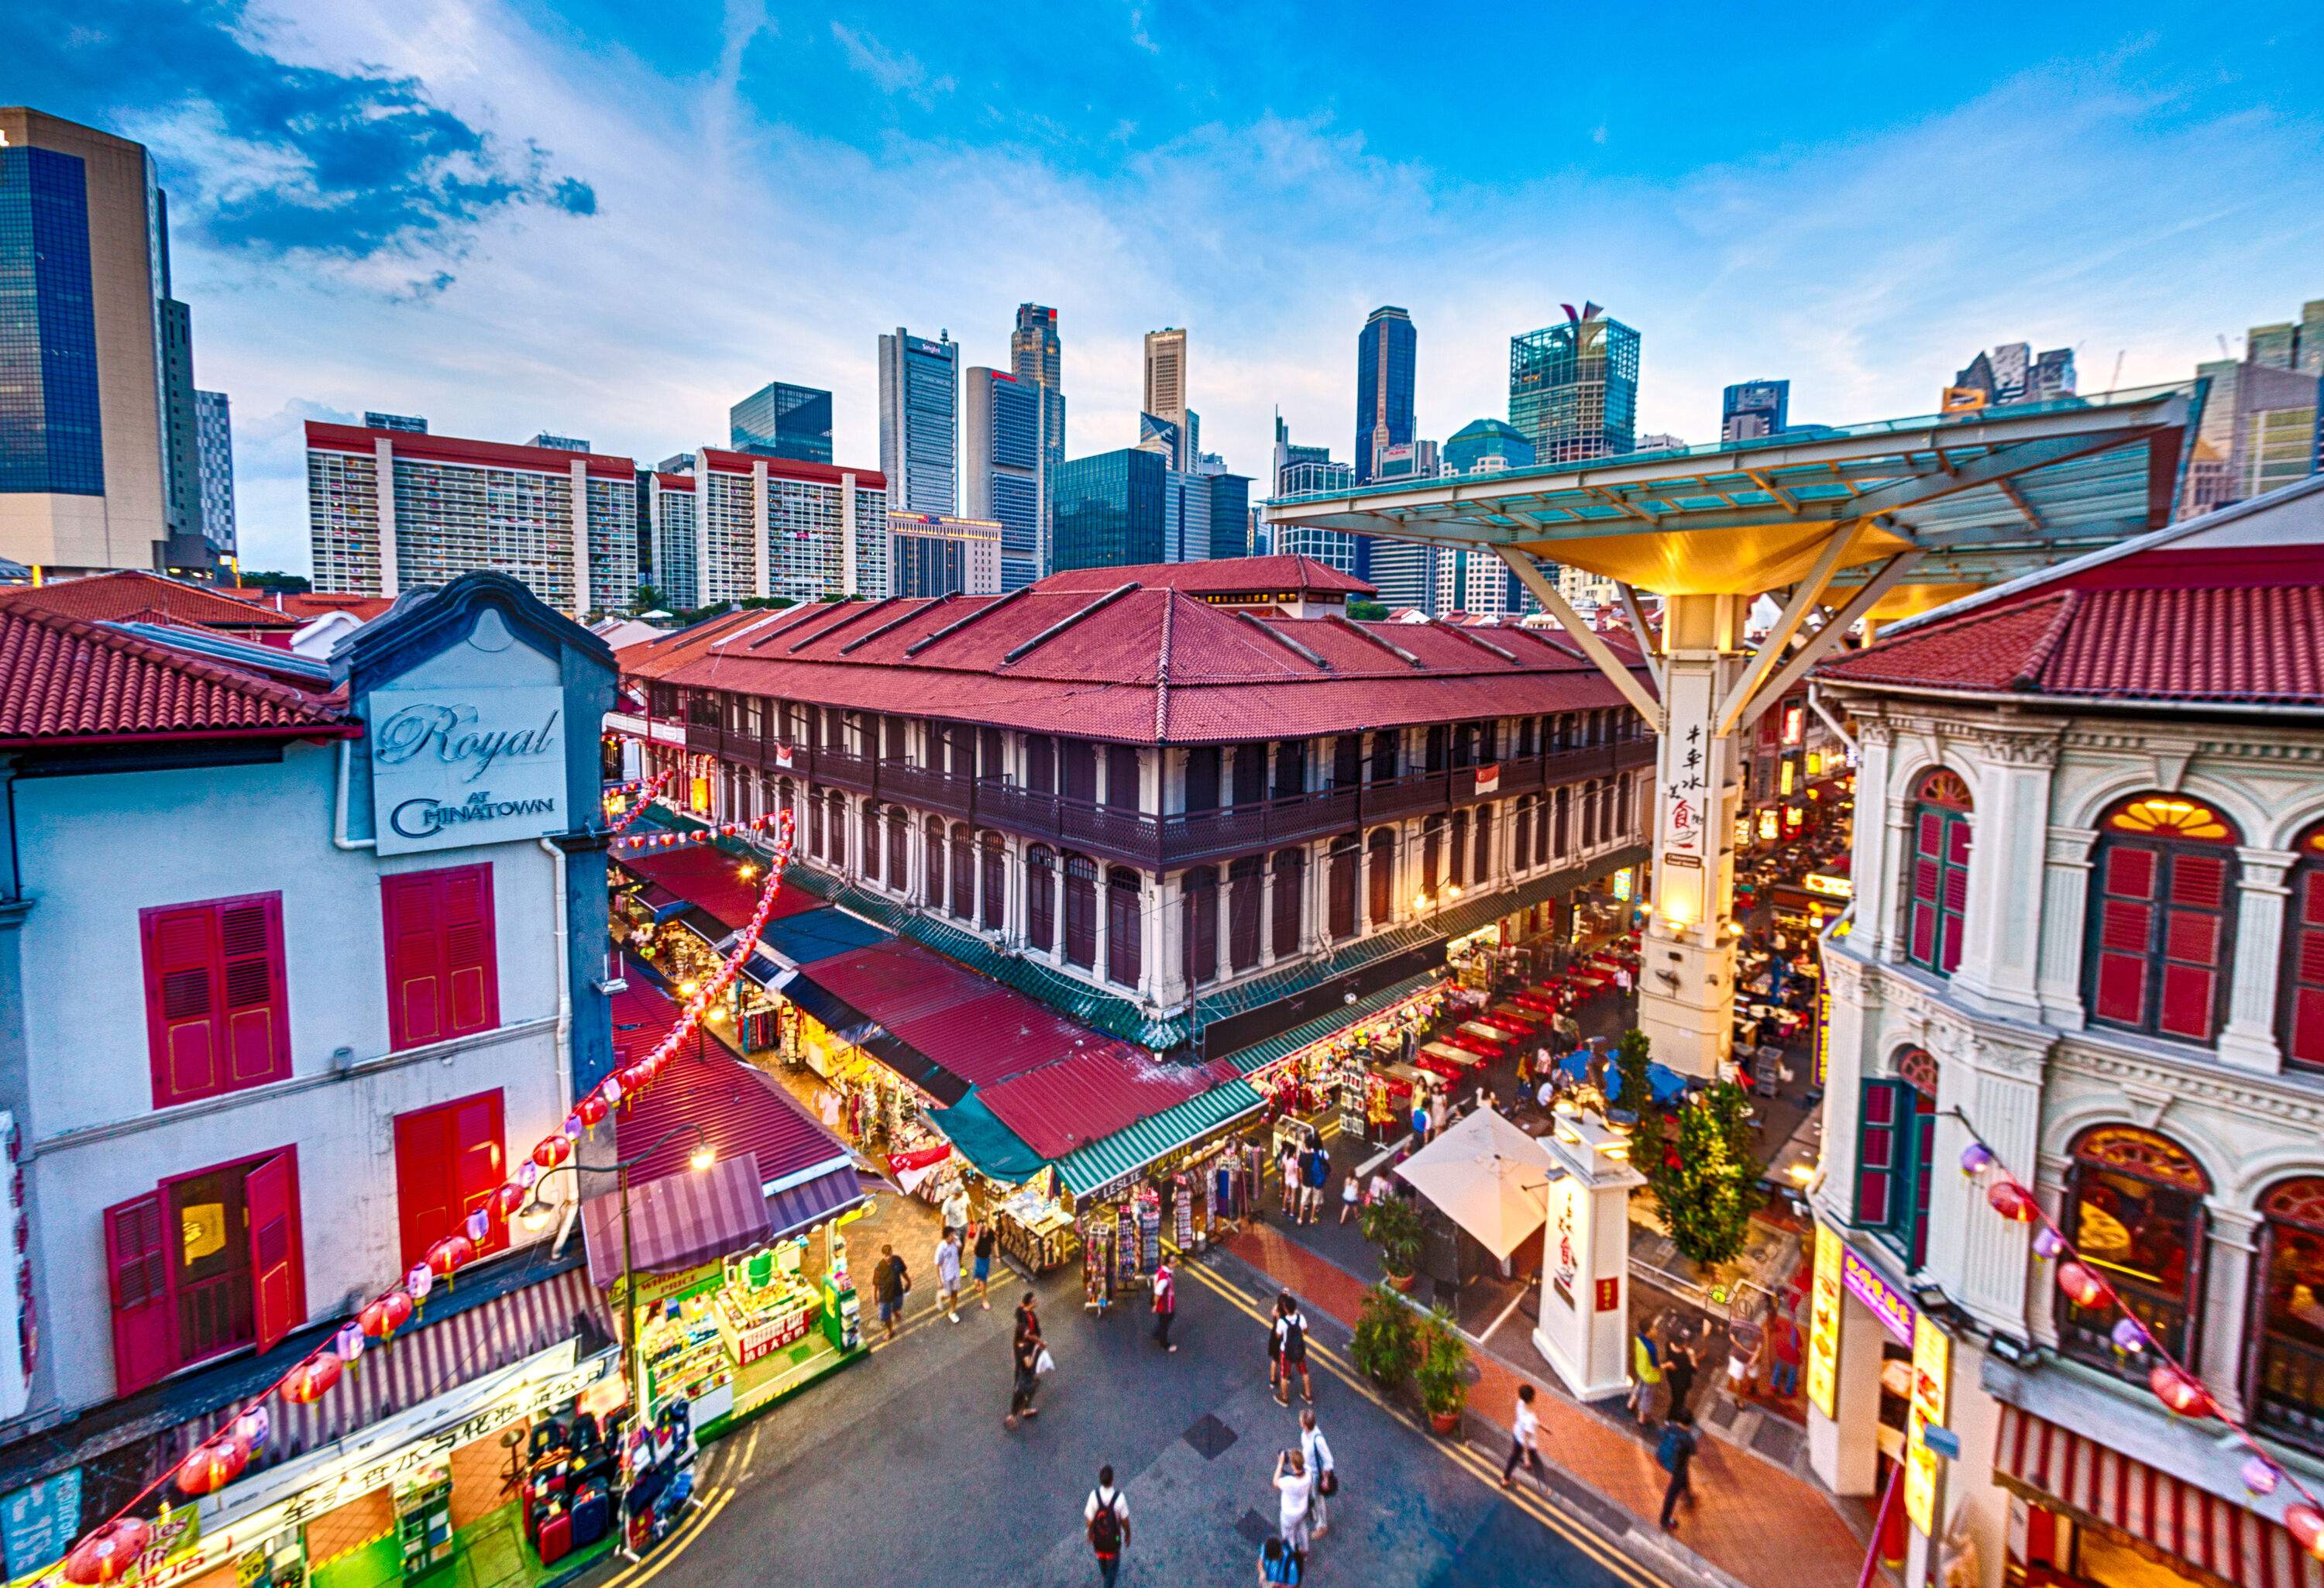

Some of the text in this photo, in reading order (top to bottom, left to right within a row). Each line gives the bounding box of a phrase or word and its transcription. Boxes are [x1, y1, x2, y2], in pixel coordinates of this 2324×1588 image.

[376, 703, 559, 782] Royal
[466, 790, 490, 804] AT
[390, 798, 555, 839] CHINATOWN
[1103, 1170, 1142, 1198] LESLIE
